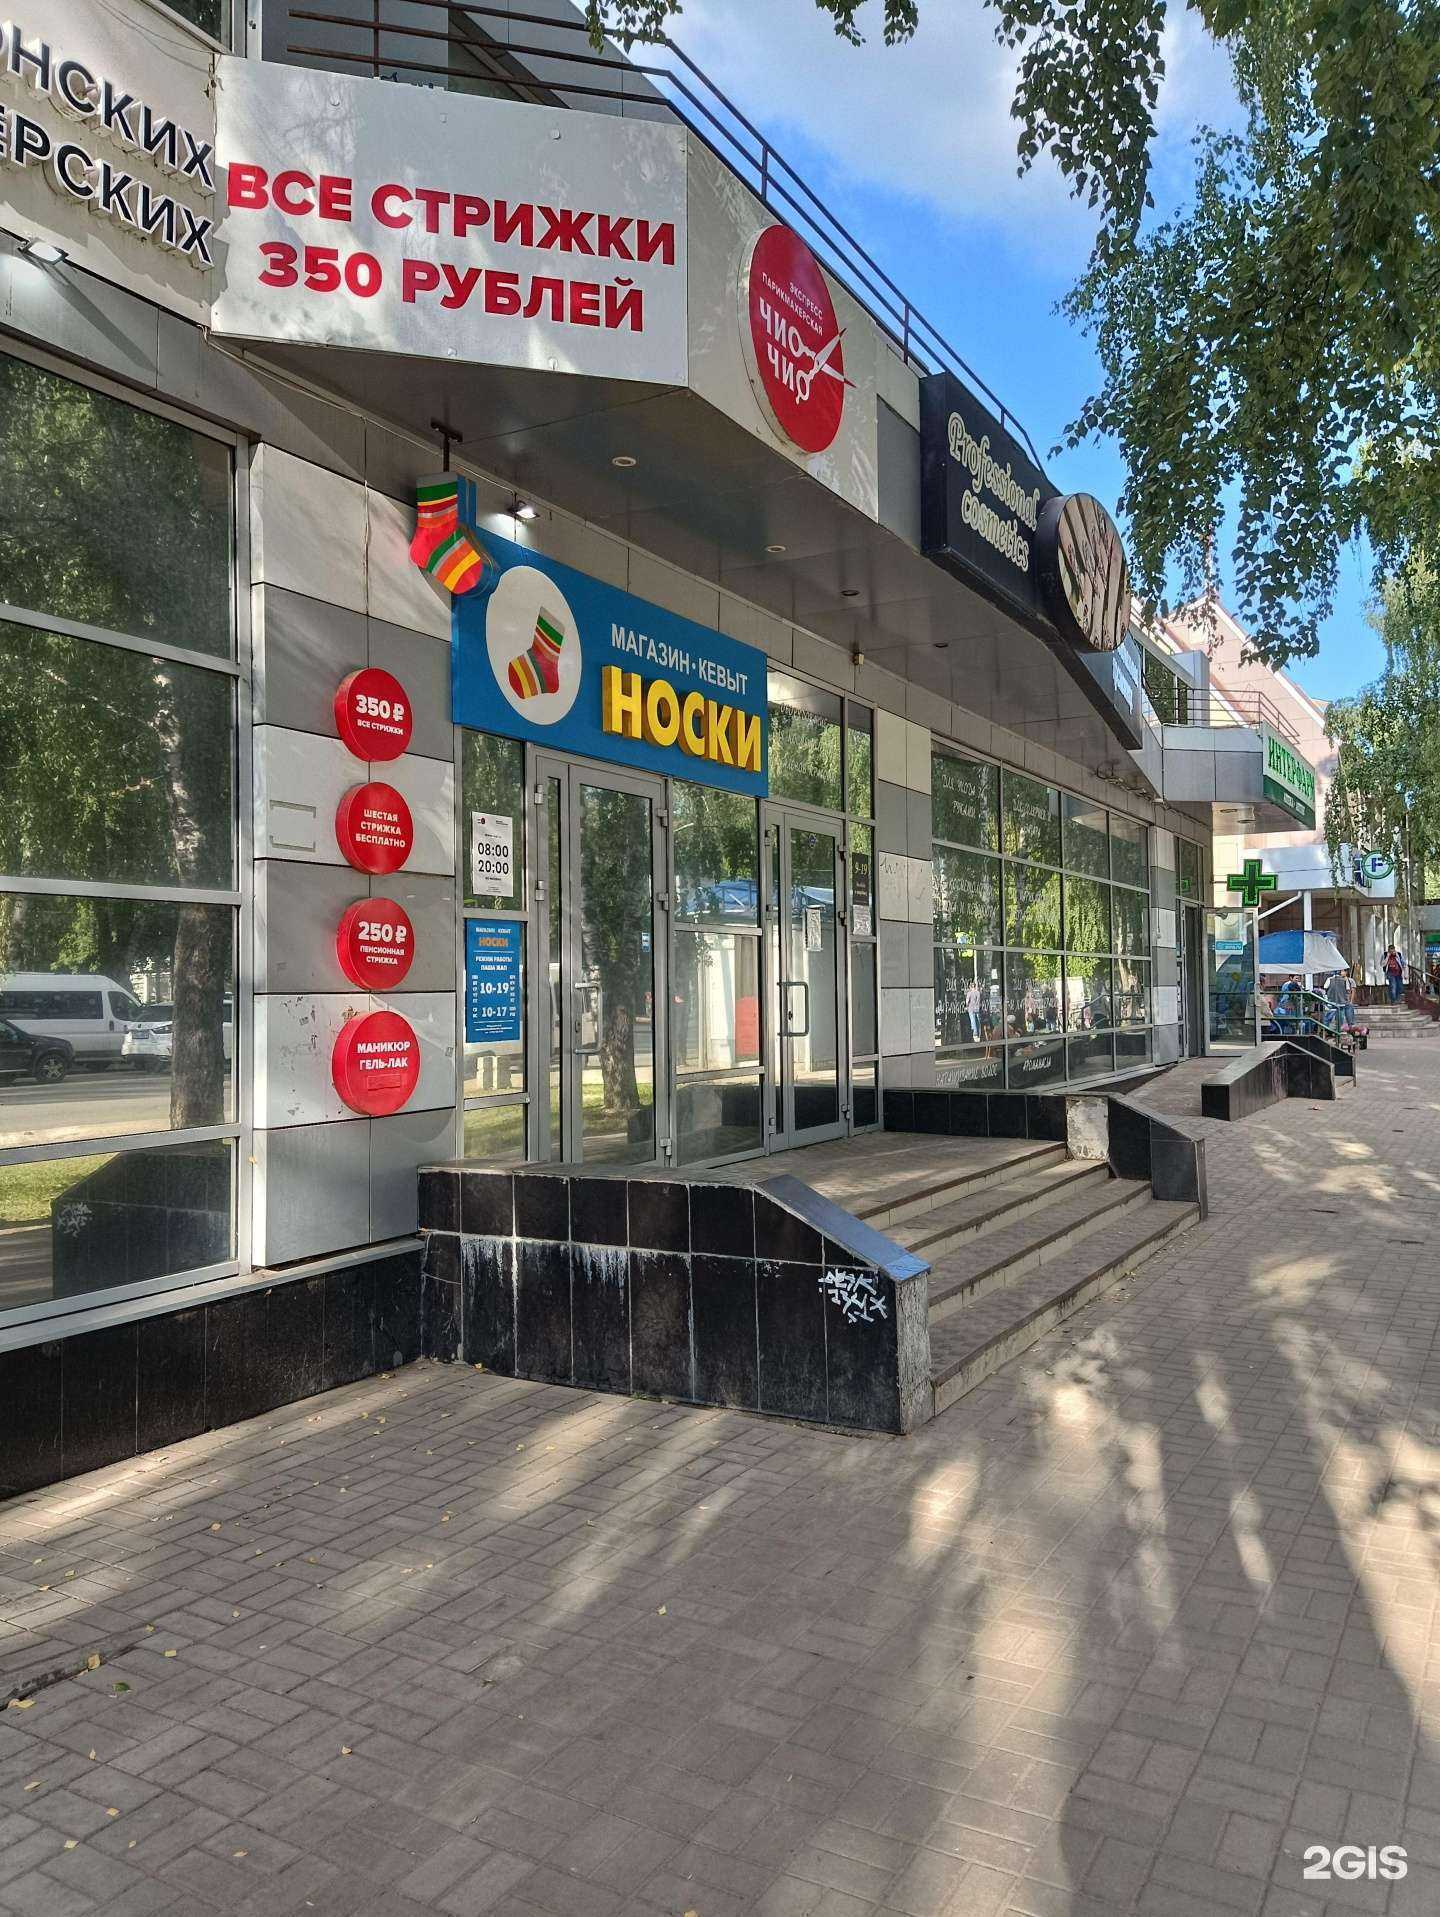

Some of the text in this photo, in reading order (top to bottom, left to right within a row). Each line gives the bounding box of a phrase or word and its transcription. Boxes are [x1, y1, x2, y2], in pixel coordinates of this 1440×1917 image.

[0, 22, 216, 193] НСКИХ
[227, 161, 676, 266] ВСЕ СТРИЖКИ
[258, 242, 644, 333] 350 РУБЛЕЙ
[762, 272, 823, 336] ПАРИКМАХЕРСКАЯ
[789, 281, 823, 321] ЭКСПРЕСС
[947, 411, 1041, 532] Professional
[355, 693, 391, 719] 350
[602, 664, 762, 773] НОСКИ
[356, 718, 404, 736] ВСЕ СТРИЖКИ
[363, 808, 398, 823] ШЕСТАЯ
[360, 820, 402, 836] СТРИЖКА
[355, 832, 406, 848] БЕСПЛАТНО
[477, 842, 509, 858] 08:00
[477, 859, 509, 875] 20:00
[358, 920, 394, 943] 250
[360, 945, 405, 956] ПЕНСИОННАЯ
[365, 955, 399, 965] СТРИЖКА
[480, 982, 510, 995] 10-19
[481, 1006, 508, 1018] 10-17
[356, 1041, 411, 1054] МАНИКЮР
[359, 1057, 408, 1071] ГЕЛЬ-ЛАК
